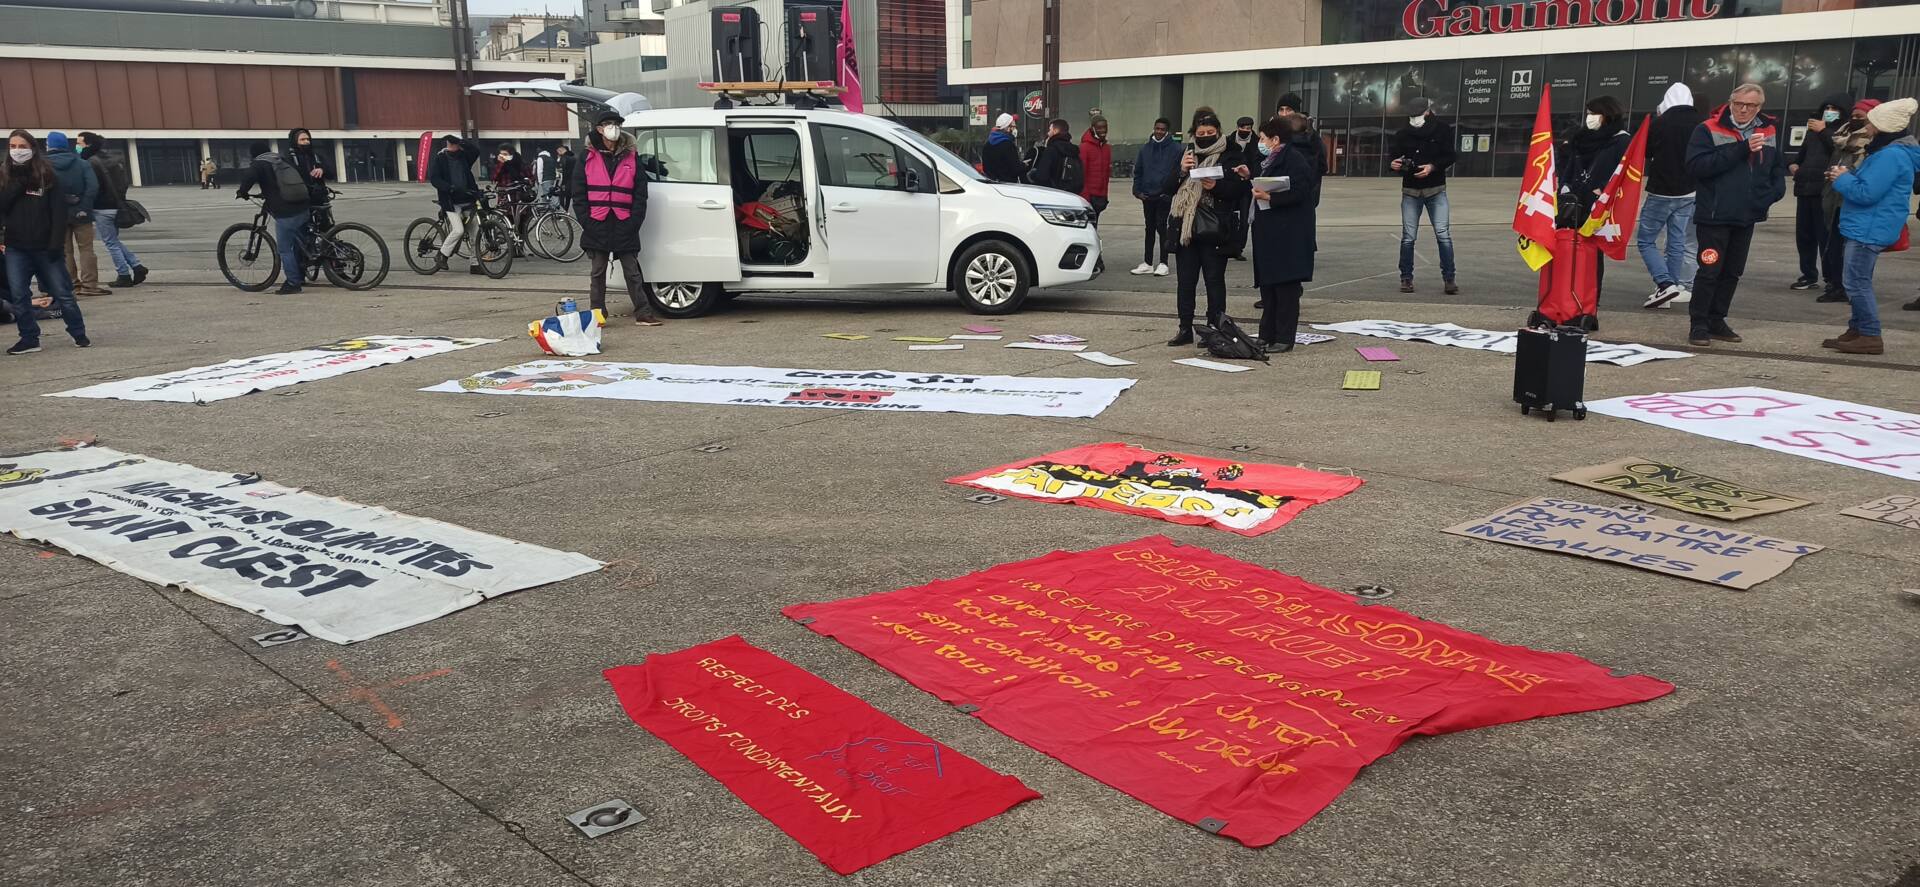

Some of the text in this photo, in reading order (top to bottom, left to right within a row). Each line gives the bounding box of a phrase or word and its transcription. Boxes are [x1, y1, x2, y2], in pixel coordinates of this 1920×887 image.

[1464, 77, 1497, 86] Expérience
[1468, 86, 1491, 95] Cinéma
[1468, 96, 1490, 104] Unique
[1510, 85, 1531, 93] DOLBY
[727, 397, 776, 405] AUX
[1489, 515, 1555, 534] LES
[1506, 506, 1753, 558] POUR BATTRE
[1538, 499, 1820, 556] SOYONS UNIES
[29, 498, 194, 543] GRAND
[168, 535, 379, 597] OUEST
[1465, 524, 1744, 584] INÉGALITÉS !
[1113, 548, 1243, 591] PLUS
[1046, 588, 1150, 632] CENTRE
[916, 611, 975, 635] sans
[972, 636, 1115, 698] conditions
[1164, 599, 1241, 625] LA
[1229, 622, 1371, 669] RUE
[935, 643, 997, 675] tous
[696, 656, 810, 720] RESPECT DES
[1149, 716, 1204, 741] UN
[1216, 704, 1273, 730] UN
[662, 696, 862, 823] DROITS FONDAMENTAUX
